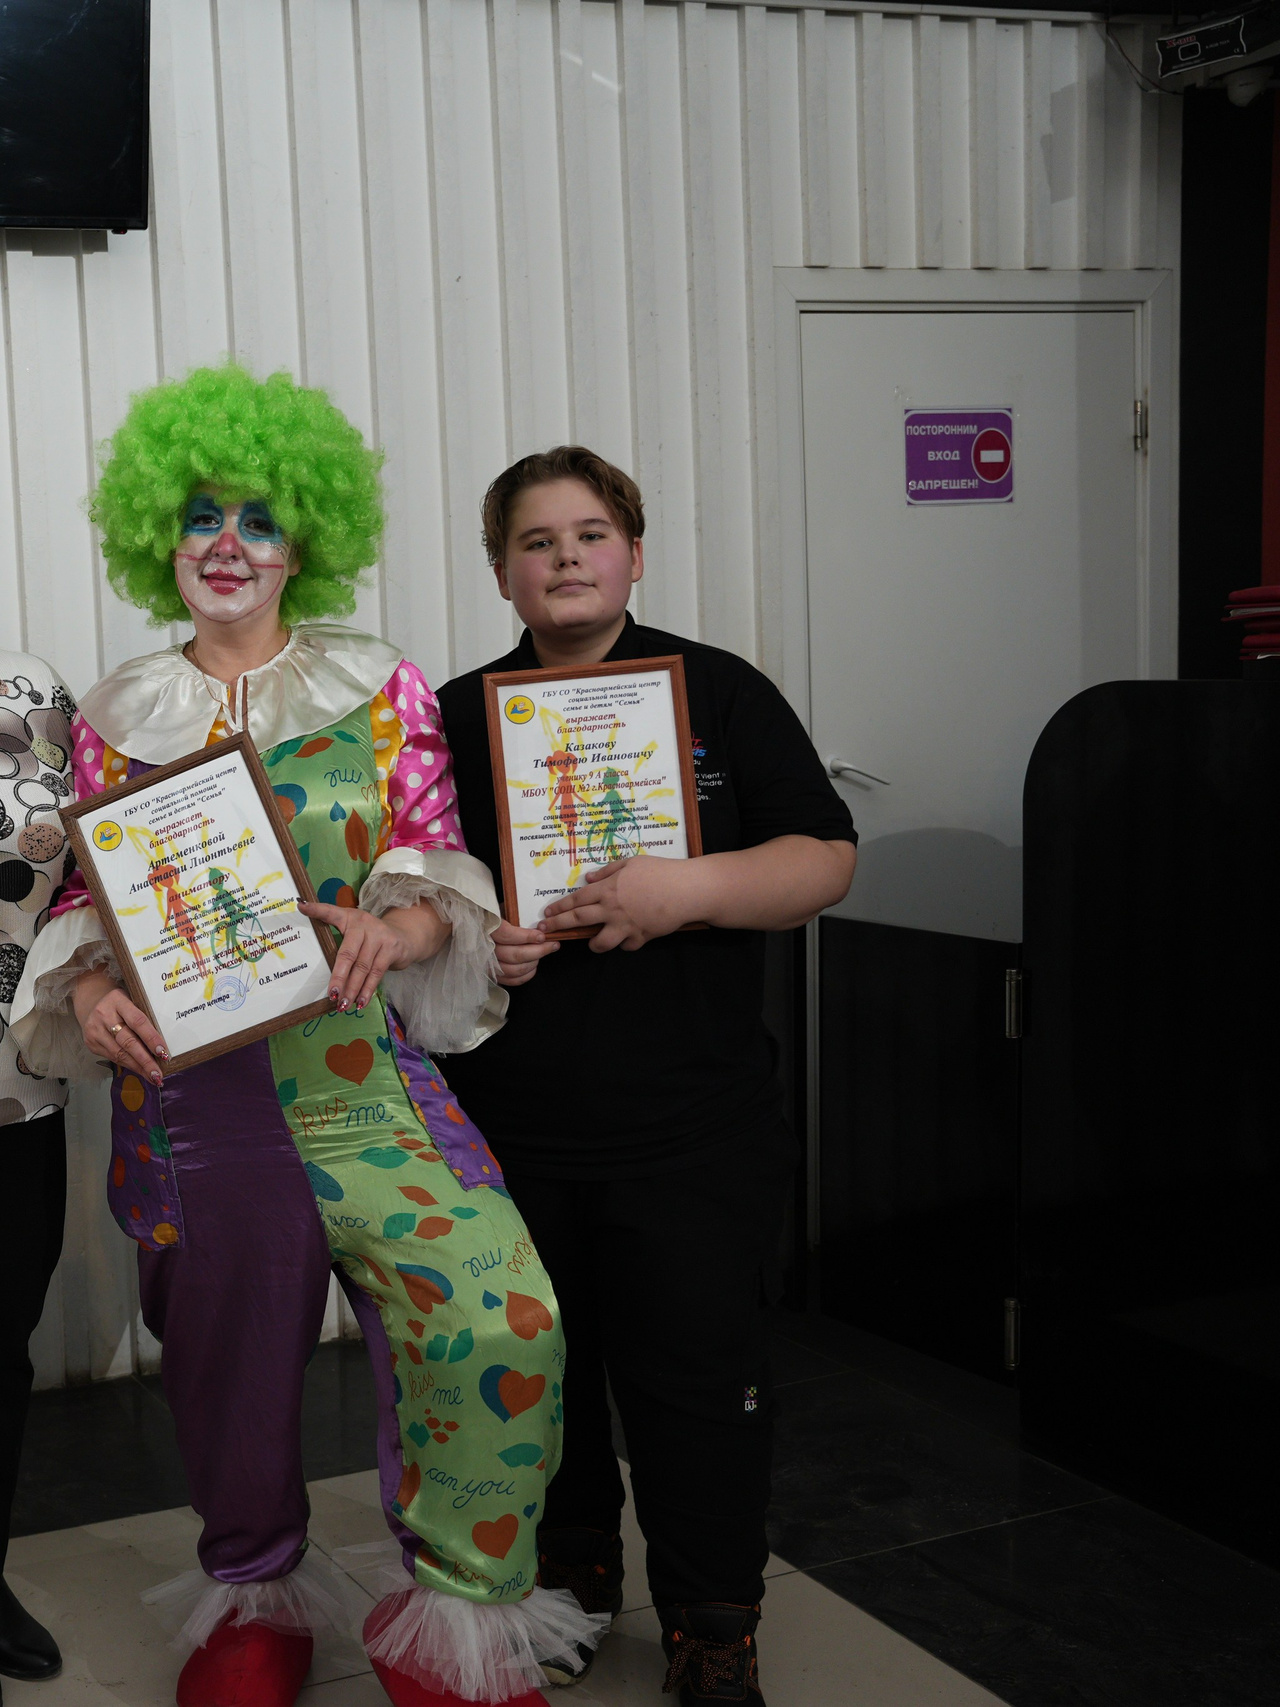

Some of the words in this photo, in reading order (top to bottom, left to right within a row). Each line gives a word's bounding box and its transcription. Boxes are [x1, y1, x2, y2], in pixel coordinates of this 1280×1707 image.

[906, 425, 978, 436] ПОСТОРОННИМ
[927, 450, 960, 461] ВХОД
[568, 693, 607, 703] социальной
[609, 691, 637, 699] помощи
[572, 682, 636, 696] "Красноармейский
[638, 680, 660, 688] центр
[589, 701, 612, 709] детям
[615, 697, 644, 706] "Семья"
[557, 720, 626, 735] благодарность
[566, 712, 616, 725] выражает
[533, 754, 587, 769] Тимофею
[591, 748, 653, 764] Ивановичу
[564, 738, 616, 753] Казакову
[521, 787, 547, 798] МБОУ
[549, 784, 575, 795] "СОШ
[577, 783, 590, 792] №2
[591, 776, 666, 793] г.Красноармейска"
[556, 773, 587, 784] ученику
[588, 771, 593, 779] 9
[603, 769, 629, 778] класса
[124, 805, 140, 817] ГБУ
[140, 800, 151, 810] СО
[152, 773, 214, 807] "Красноармейский
[215, 764, 237, 780] центр
[150, 794, 189, 815] социальной
[190, 782, 217, 798] помощи
[148, 812, 167, 825] семье
[173, 800, 195, 814] детям
[197, 786, 226, 804] "Семья"
[149, 815, 215, 850] благодарность
[155, 810, 203, 837] выражает
[146, 830, 226, 872] Артеменковой
[128, 862, 187, 894] Анастасии
[168, 871, 231, 904] аниматору
[534, 886, 565, 896] Директор
[161, 969, 173, 981] От
[174, 963, 190, 975] всей
[191, 955, 211, 970] души
[212, 943, 241, 960] желаем
[242, 936, 258, 948] Вам
[259, 922, 293, 942] здоровья,
[163, 966, 213, 993] благополучия,
[214, 955, 242, 973] успехов
[250, 930, 302, 959] процветания!
[273, 961, 307, 980] Матяшова
[174, 1001, 206, 1020] Директор
[207, 992, 230, 1008] центра
[293, 1097, 348, 1138] kiss
[345, 1103, 394, 1128] me
[408, 1370, 435, 1402] kiss
[432, 1386, 464, 1405] me
[425, 1467, 458, 1491] can
[452, 1478, 516, 1509] you
[487, 1570, 527, 1598] me
